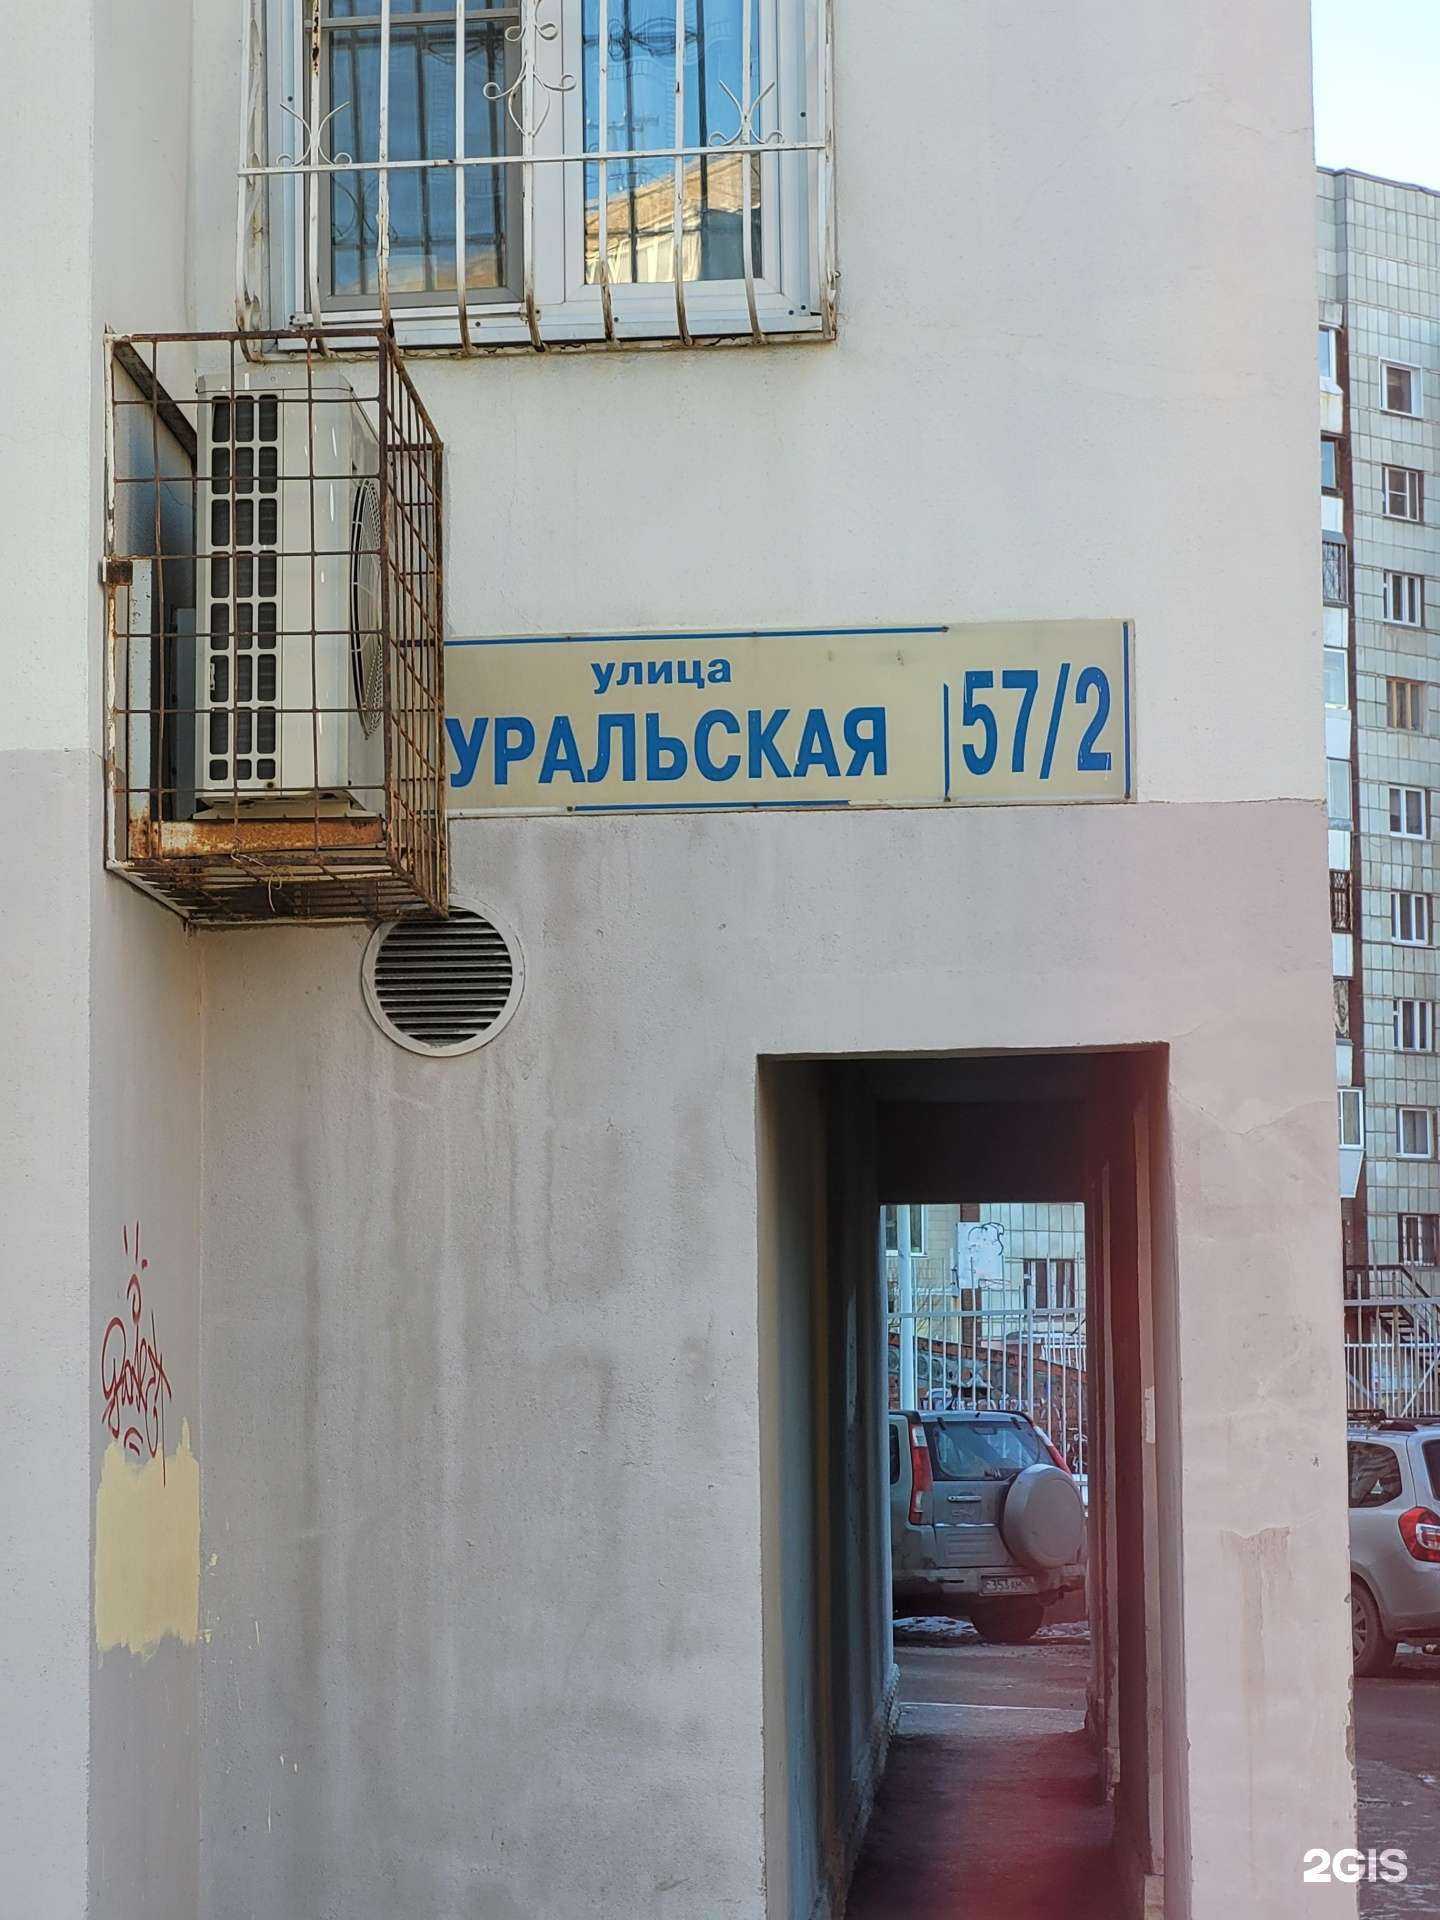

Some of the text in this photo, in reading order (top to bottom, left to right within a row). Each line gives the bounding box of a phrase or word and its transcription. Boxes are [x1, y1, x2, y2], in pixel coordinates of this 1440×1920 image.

[591, 658, 732, 695] улица
[445, 706, 888, 788] УРАЛЬСКАЯ
[962, 662, 1112, 780] 57/2
